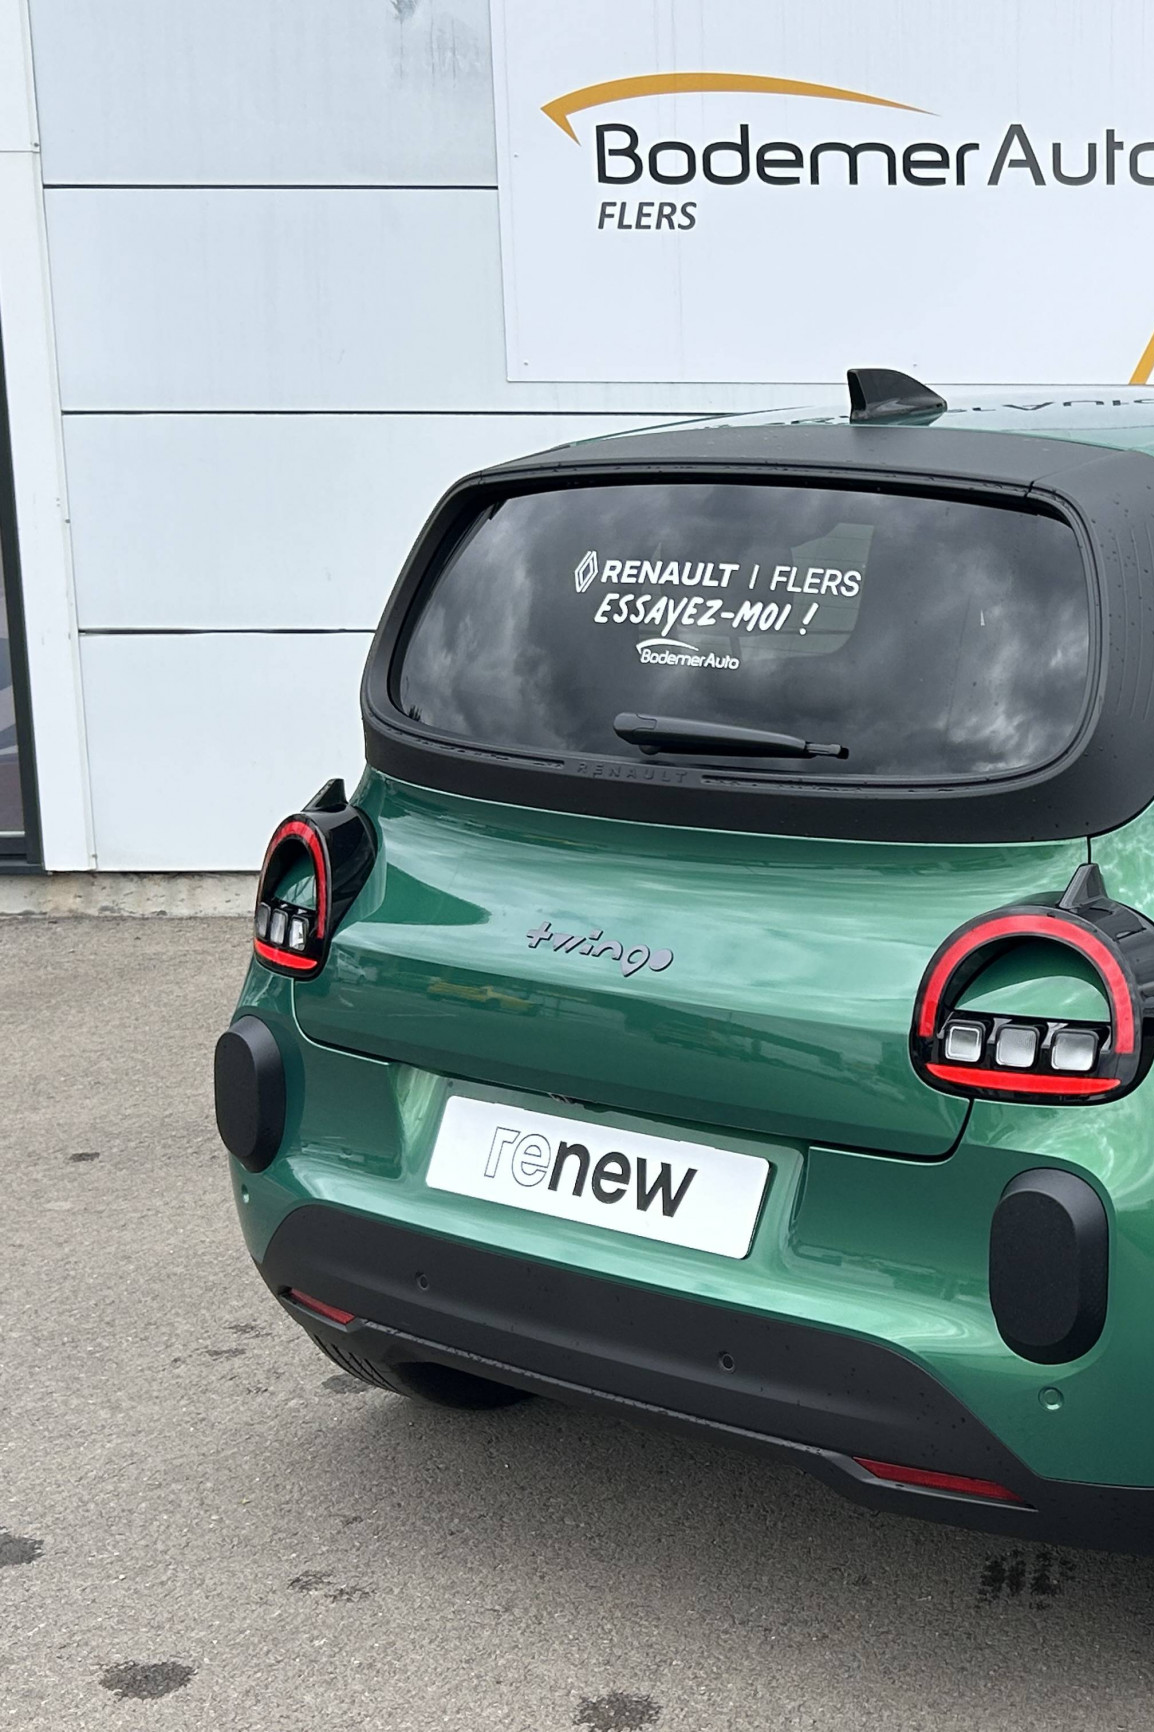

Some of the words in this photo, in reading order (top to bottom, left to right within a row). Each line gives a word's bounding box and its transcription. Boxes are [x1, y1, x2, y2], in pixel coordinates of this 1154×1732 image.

[597, 201, 698, 231] FLERS
[600, 559, 740, 588] RENAULT
[769, 565, 862, 597] FLERS
[593, 592, 792, 637] ESSAYEZ-MOI
[640, 648, 740, 670] BodemerAuto
[577, 761, 688, 783] RENAULT
[483, 1125, 699, 1218] renew
